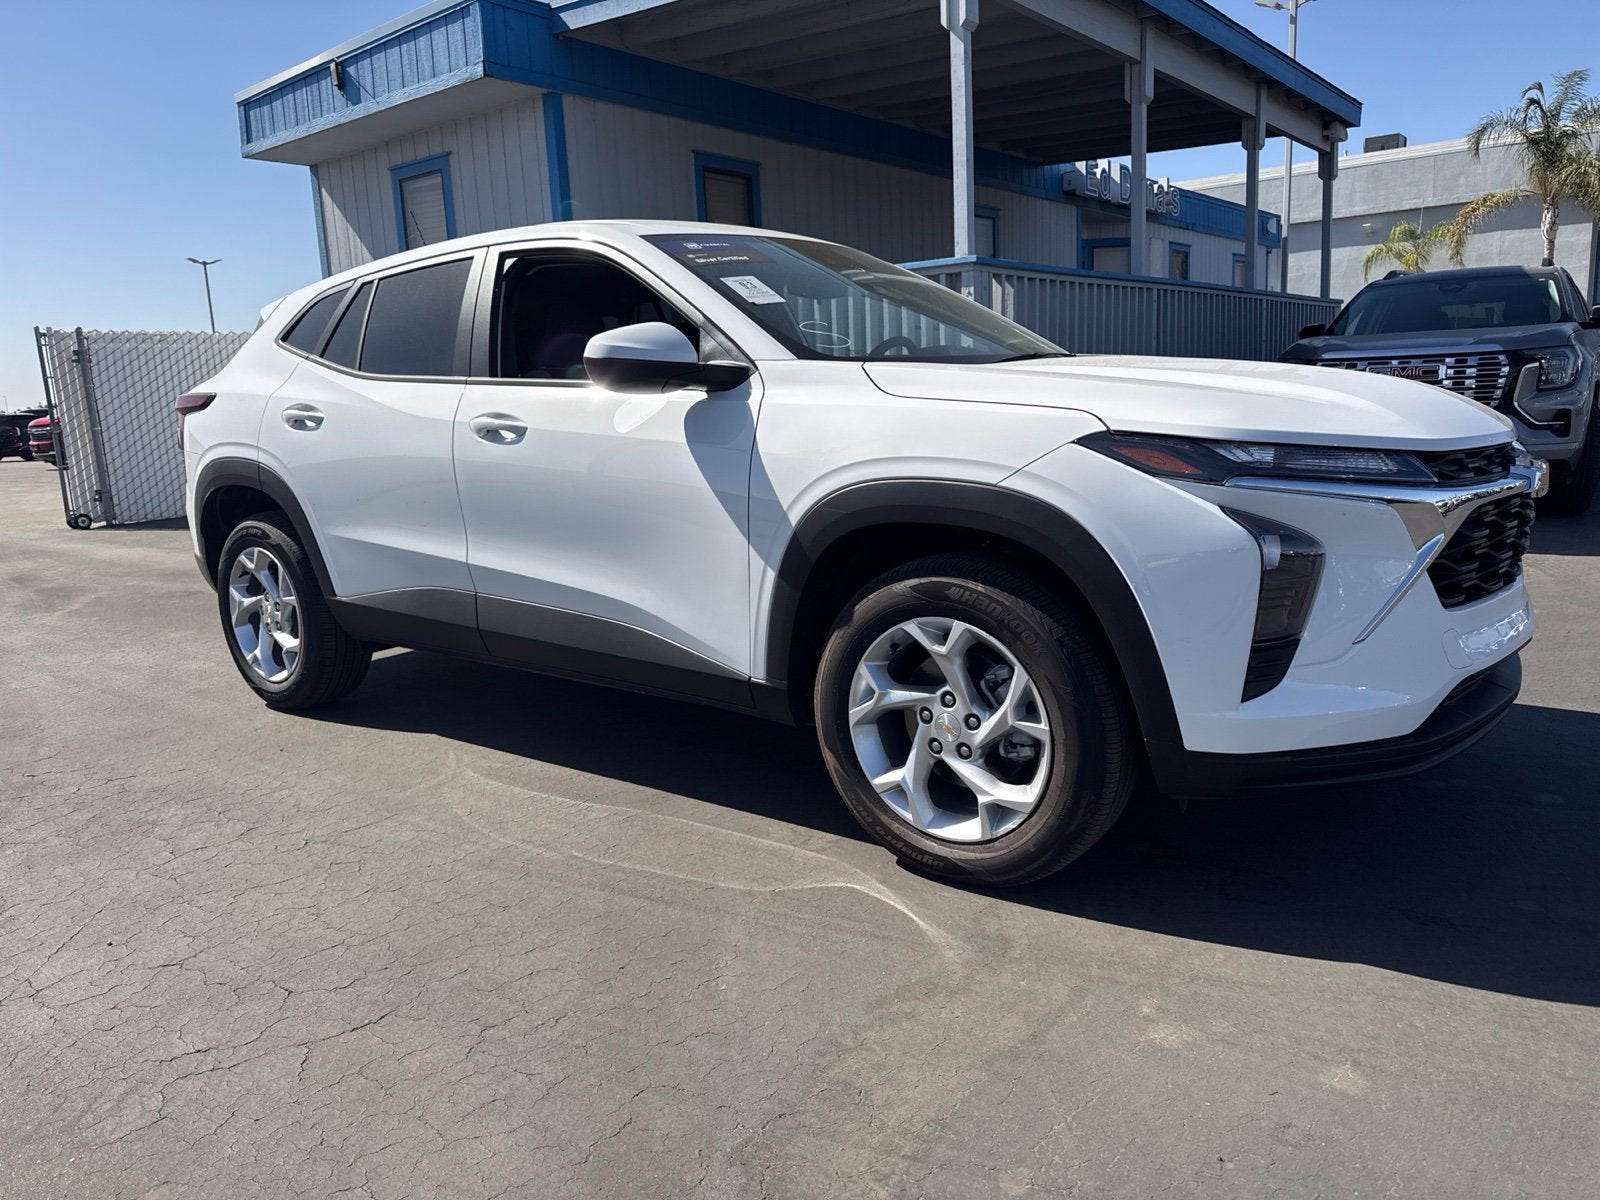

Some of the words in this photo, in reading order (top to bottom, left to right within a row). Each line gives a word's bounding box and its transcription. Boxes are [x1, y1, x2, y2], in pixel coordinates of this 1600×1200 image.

[1084, 160, 1112, 200] Ed
[1119, 162, 1181, 217] Dna's
[1369, 366, 1439, 379] GMC
